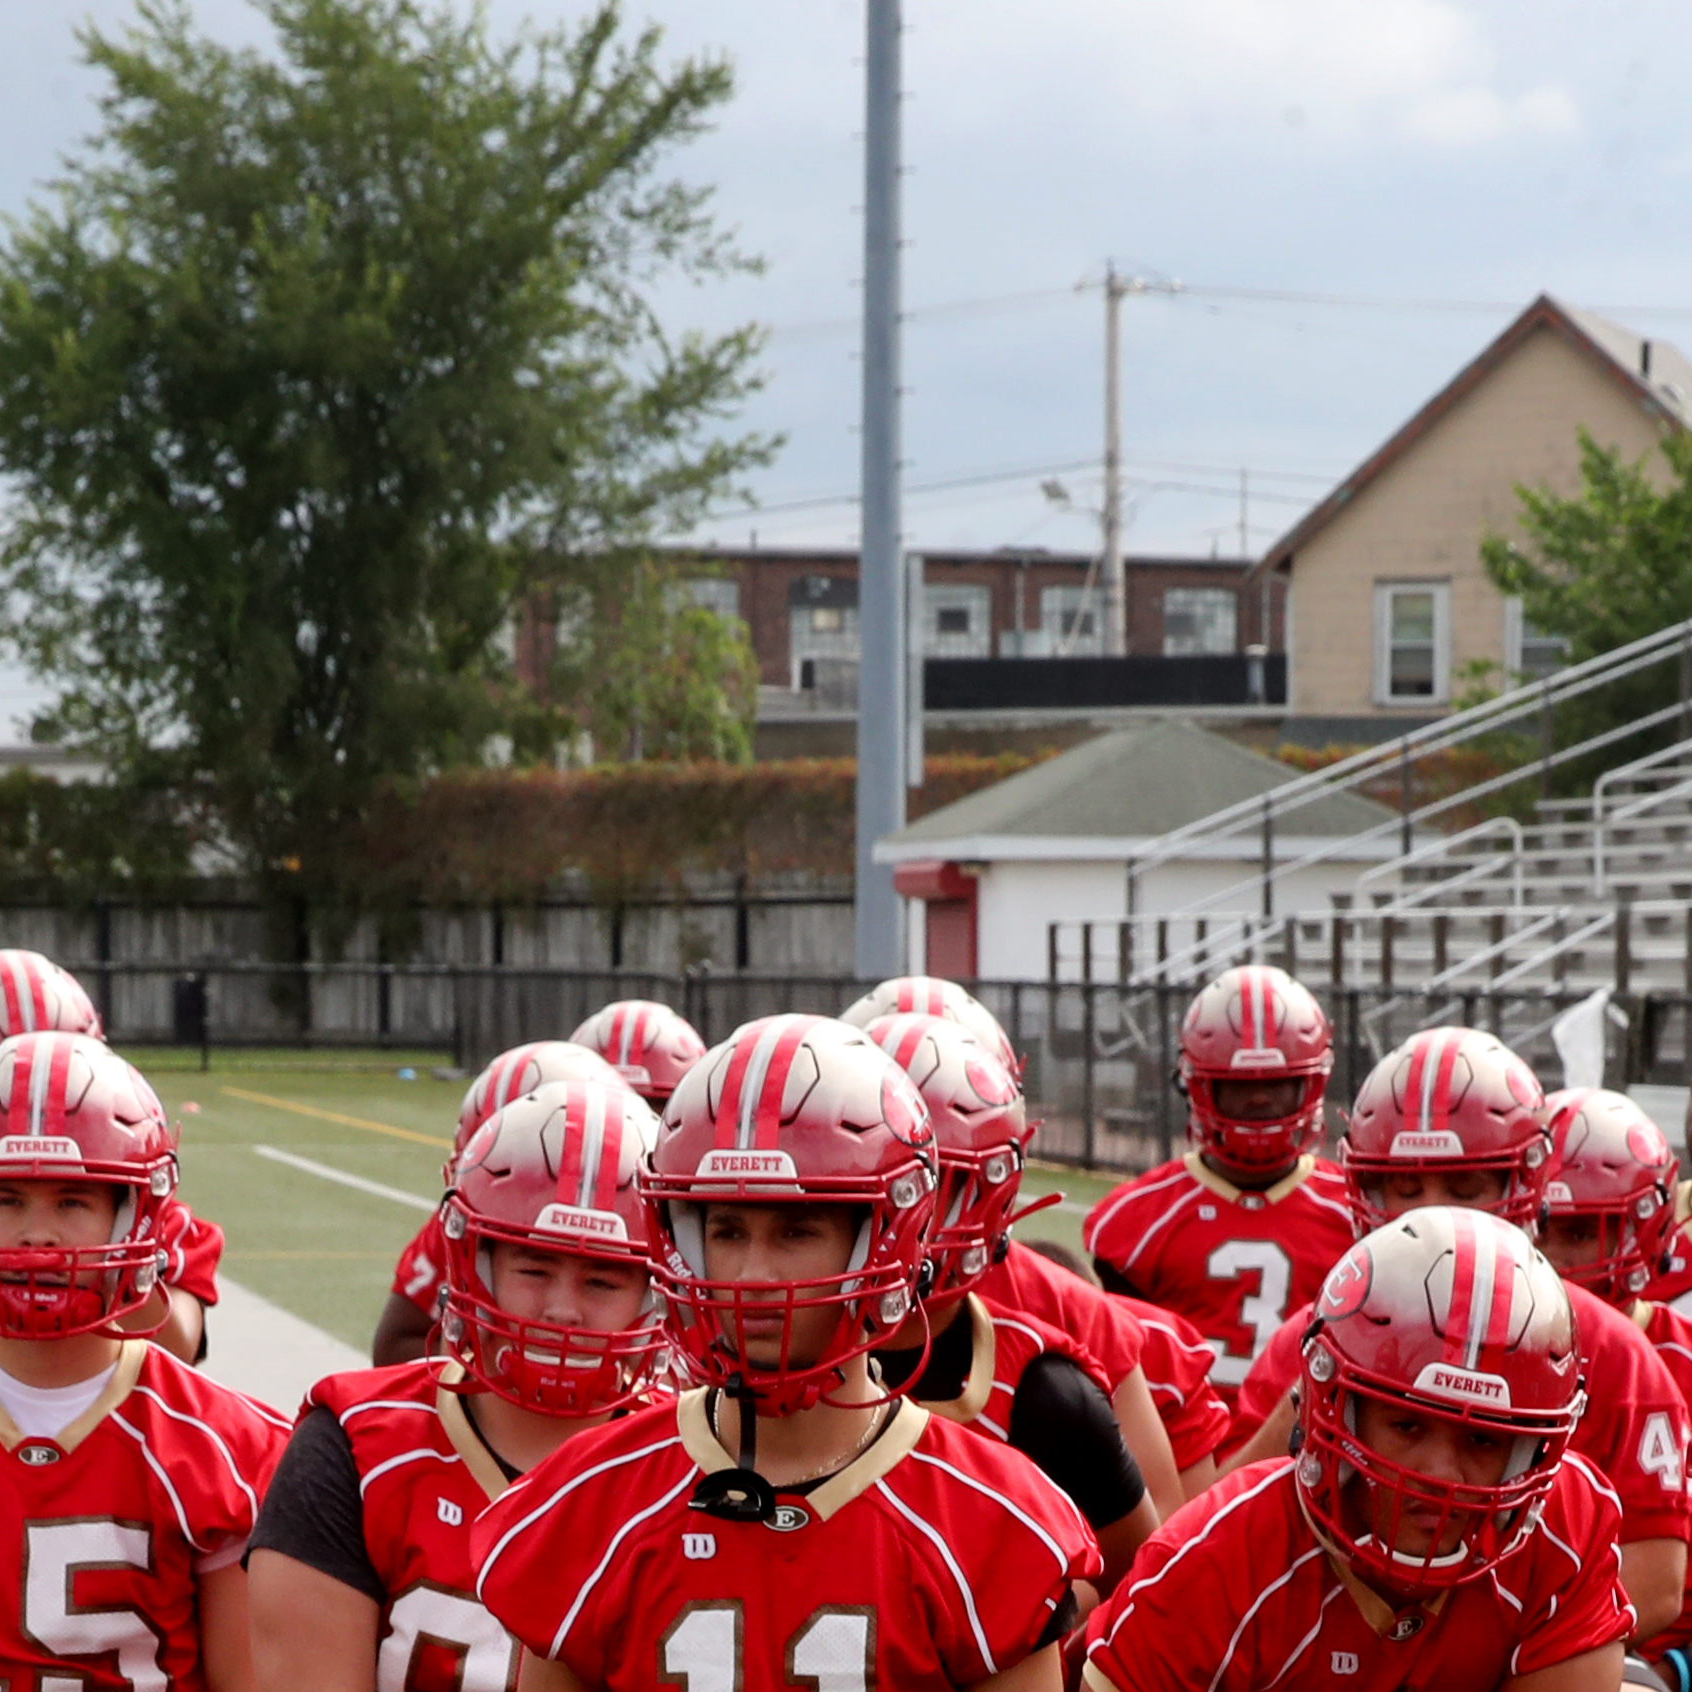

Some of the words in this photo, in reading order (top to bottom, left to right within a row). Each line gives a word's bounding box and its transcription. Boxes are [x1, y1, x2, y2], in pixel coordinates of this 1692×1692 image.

[5, 1140, 70, 1154] EVERETT
[710, 1156, 784, 1172] EVERETT
[550, 1211, 617, 1234] EVERETT
[1323, 1253, 1364, 1309] E
[1207, 1239, 1292, 1387] 3
[1432, 1372, 1503, 1398] EVERETT
